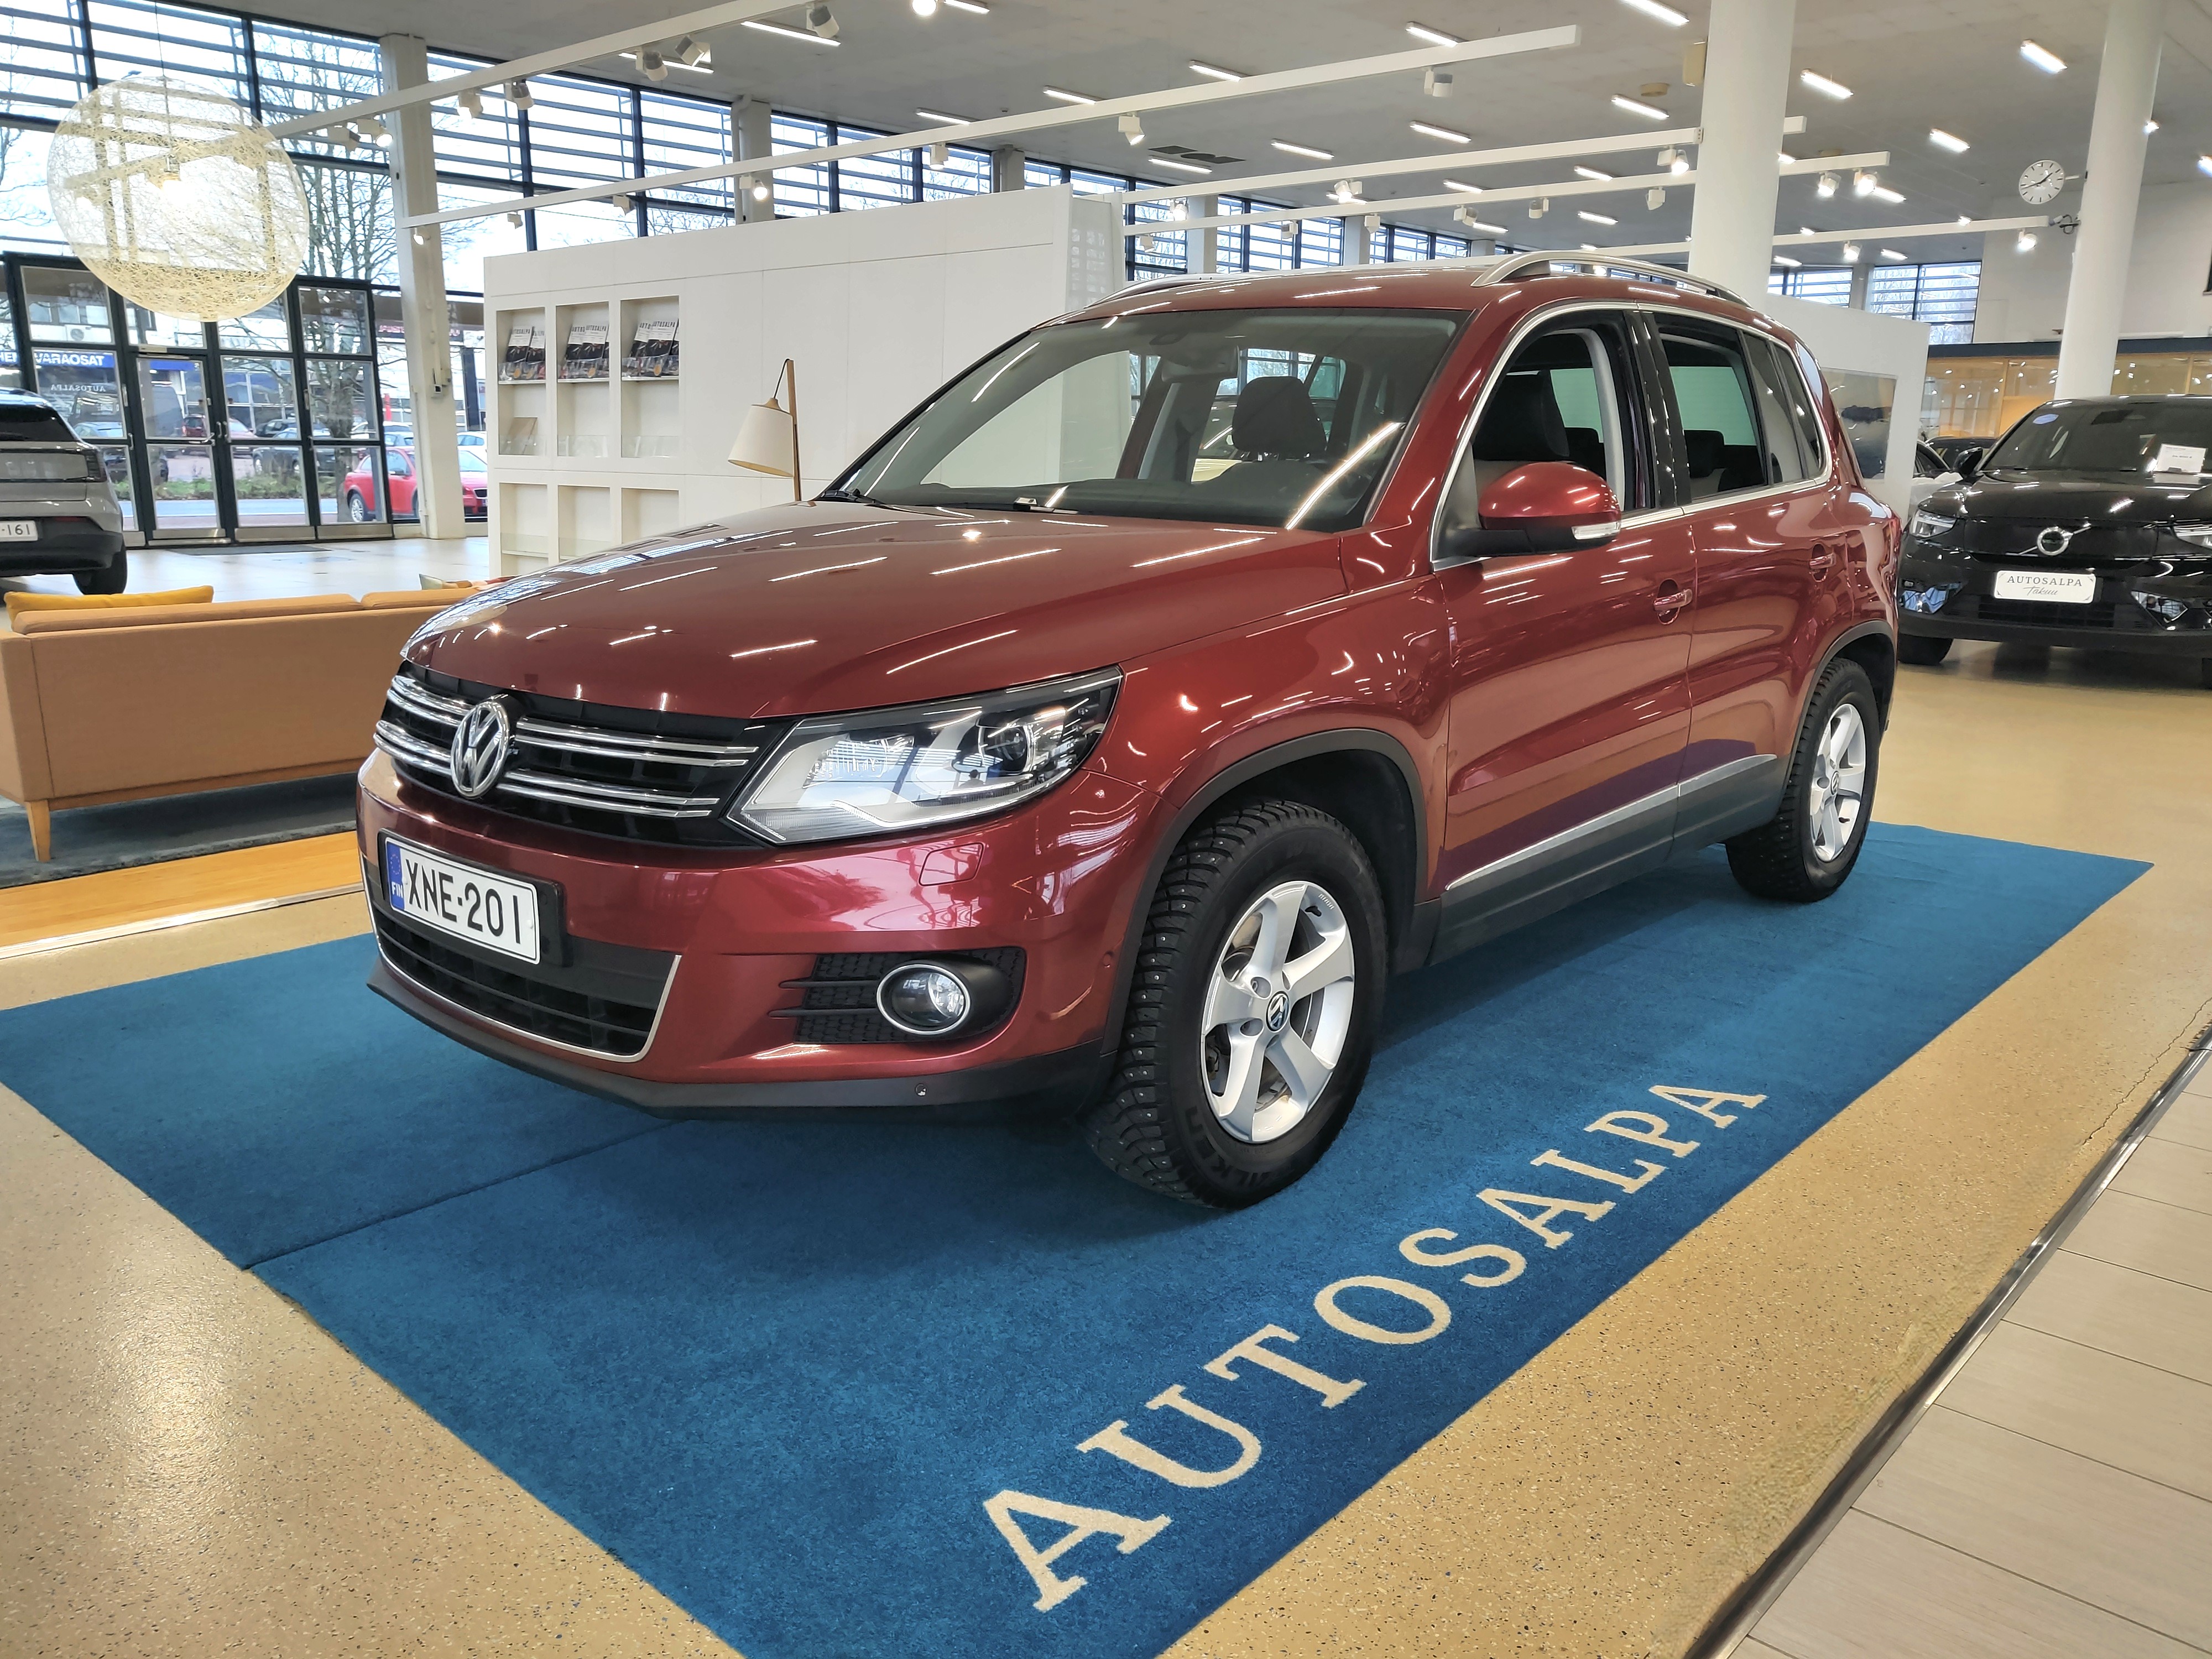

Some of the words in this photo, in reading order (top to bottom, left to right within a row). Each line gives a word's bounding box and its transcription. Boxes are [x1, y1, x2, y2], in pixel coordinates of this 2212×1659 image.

[34, 352, 105, 366] VARAOSAT
[2007, 576, 2083, 587] AUTOSALPA
[2023, 585, 2058, 596] Takuu
[392, 881, 404, 899] FIN
[405, 858, 521, 945] XNE-201
[983, 1084, 1767, 1613] AUTOSALPA
